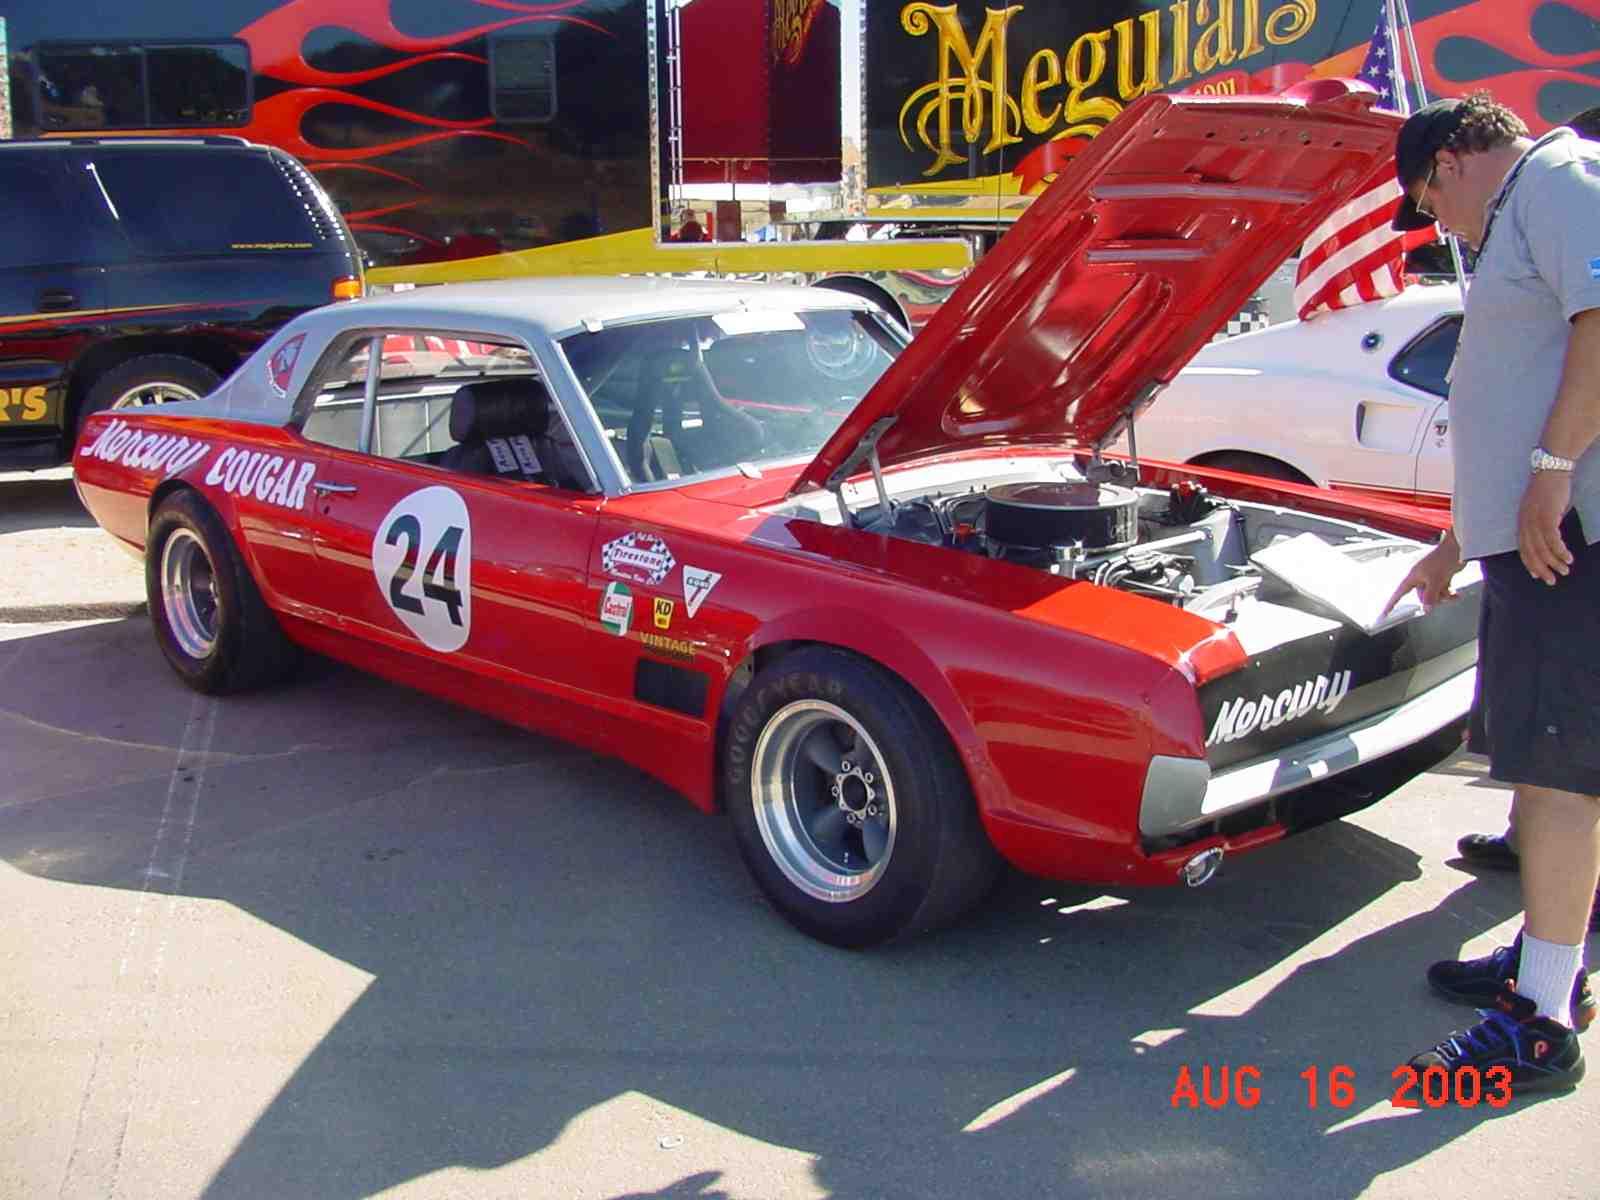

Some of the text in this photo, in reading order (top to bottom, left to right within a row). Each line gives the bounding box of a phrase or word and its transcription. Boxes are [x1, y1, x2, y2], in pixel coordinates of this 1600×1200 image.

[80, 418, 317, 510] Mercury COUGAR
[385, 514, 465, 627] 24
[614, 548, 662, 567] Firestone
[640, 631, 697, 655] VINTAGE
[1205, 670, 1352, 746] Mercury
